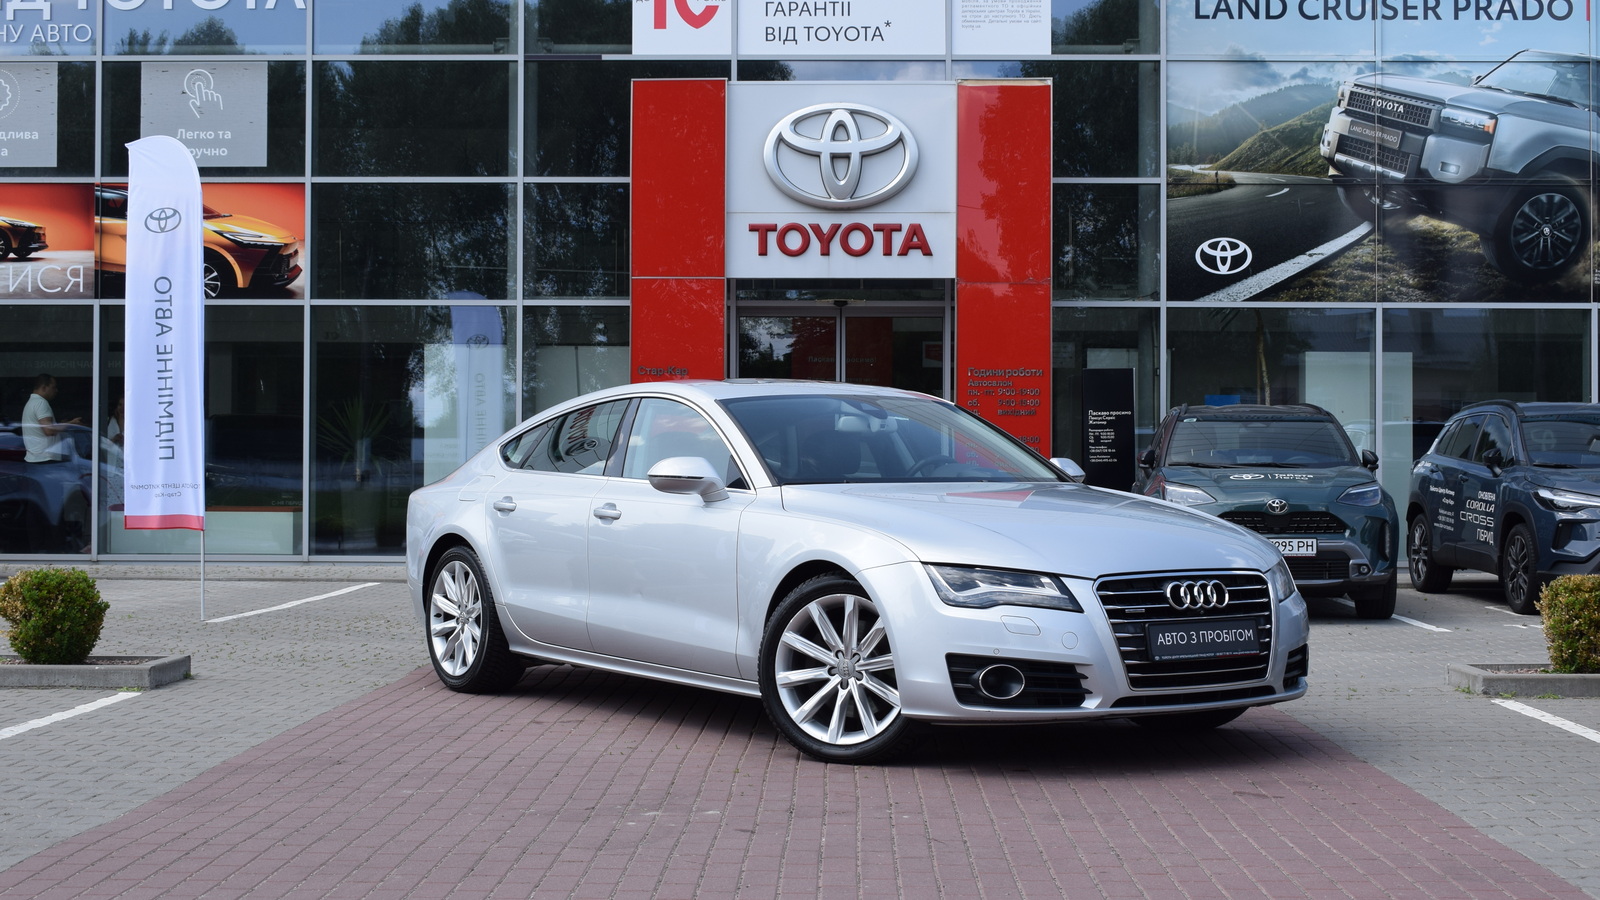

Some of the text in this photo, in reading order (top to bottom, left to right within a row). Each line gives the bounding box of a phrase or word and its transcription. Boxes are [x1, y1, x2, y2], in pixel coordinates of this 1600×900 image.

[1194, 0, 1573, 21] LAND CRUISER PRADO
[30, 24, 92, 42] АВТО
[765, 26, 798, 45] ВІД
[1371, 98, 1404, 113] TOYOTA
[176, 129, 214, 139] Легко
[1350, 125, 1362, 133] LAND
[188, 148, 228, 158] ручно
[748, 222, 934, 257] TOYOTA
[0, 266, 83, 292] ИСЯ
[638, 365, 688, 376] Стар-Кар
[967, 367, 1043, 378] Години роботи
[968, 379, 1013, 387] Автосалон
[998, 408, 1036, 416] вихідний
[1466, 500, 1495, 513] COROLLA
[1460, 510, 1494, 527] CROSS
[1476, 529, 1494, 546] ГІБРИД
[1272, 541, 1314, 552] 295 PH
[1157, 631, 1187, 645] АВТО
[1200, 629, 1254, 643] ПРОБІГОМ
